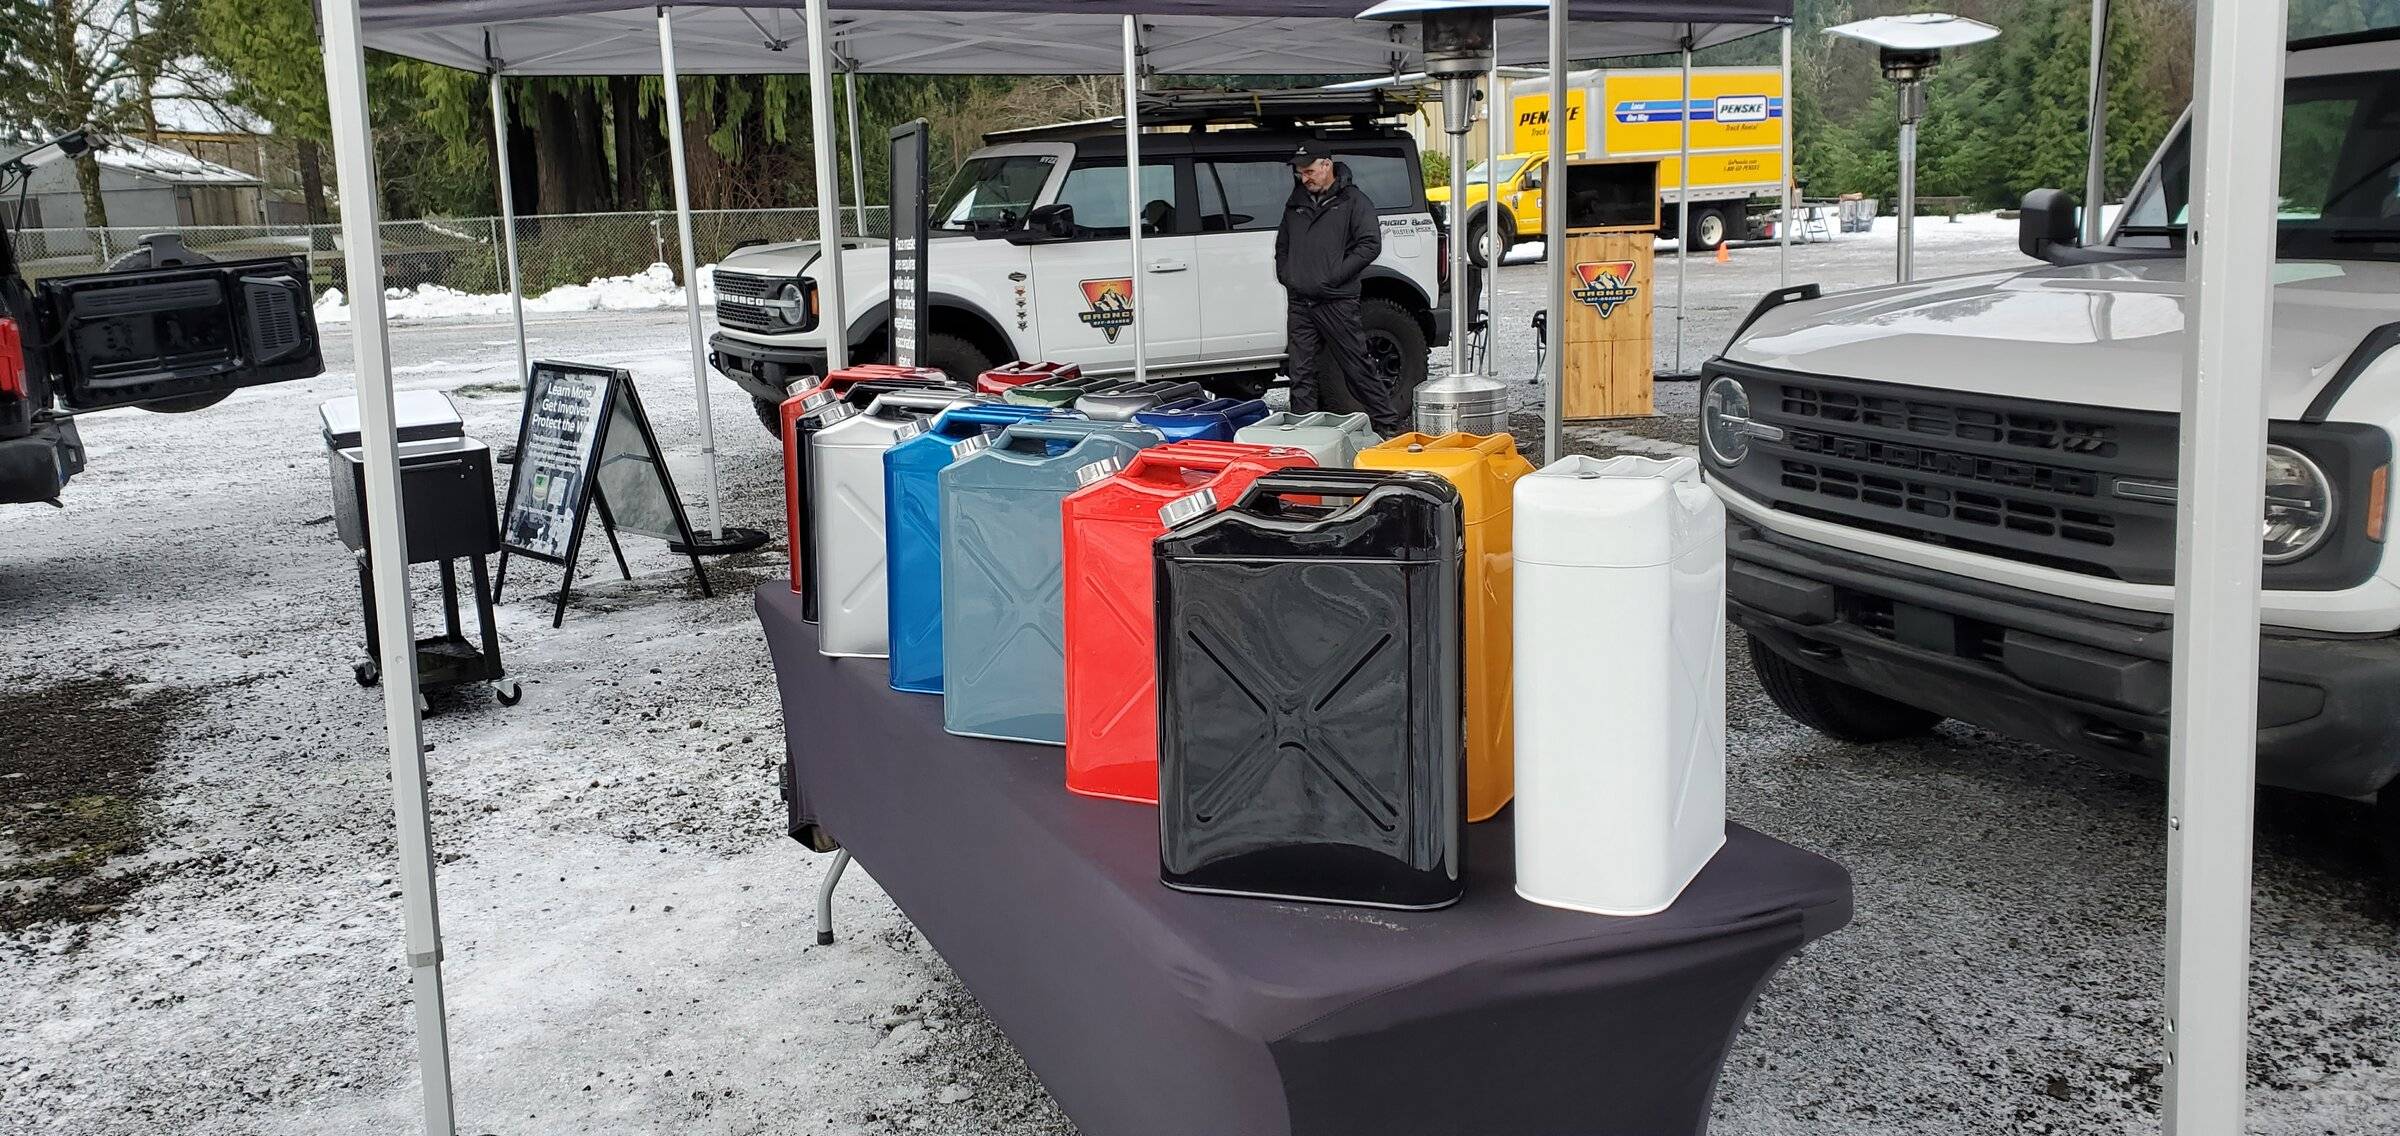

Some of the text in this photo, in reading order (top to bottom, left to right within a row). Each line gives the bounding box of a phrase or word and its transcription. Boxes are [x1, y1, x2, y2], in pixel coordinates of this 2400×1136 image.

[1519, 106, 1580, 127] PENE
[1720, 103, 1763, 114] PENSKE
[1577, 289, 1634, 298] BRONCO
[547, 382, 593, 400] Learn More
[542, 399, 591, 416] Get Involved
[532, 414, 561, 430] Protect
[562, 418, 576, 432] the
